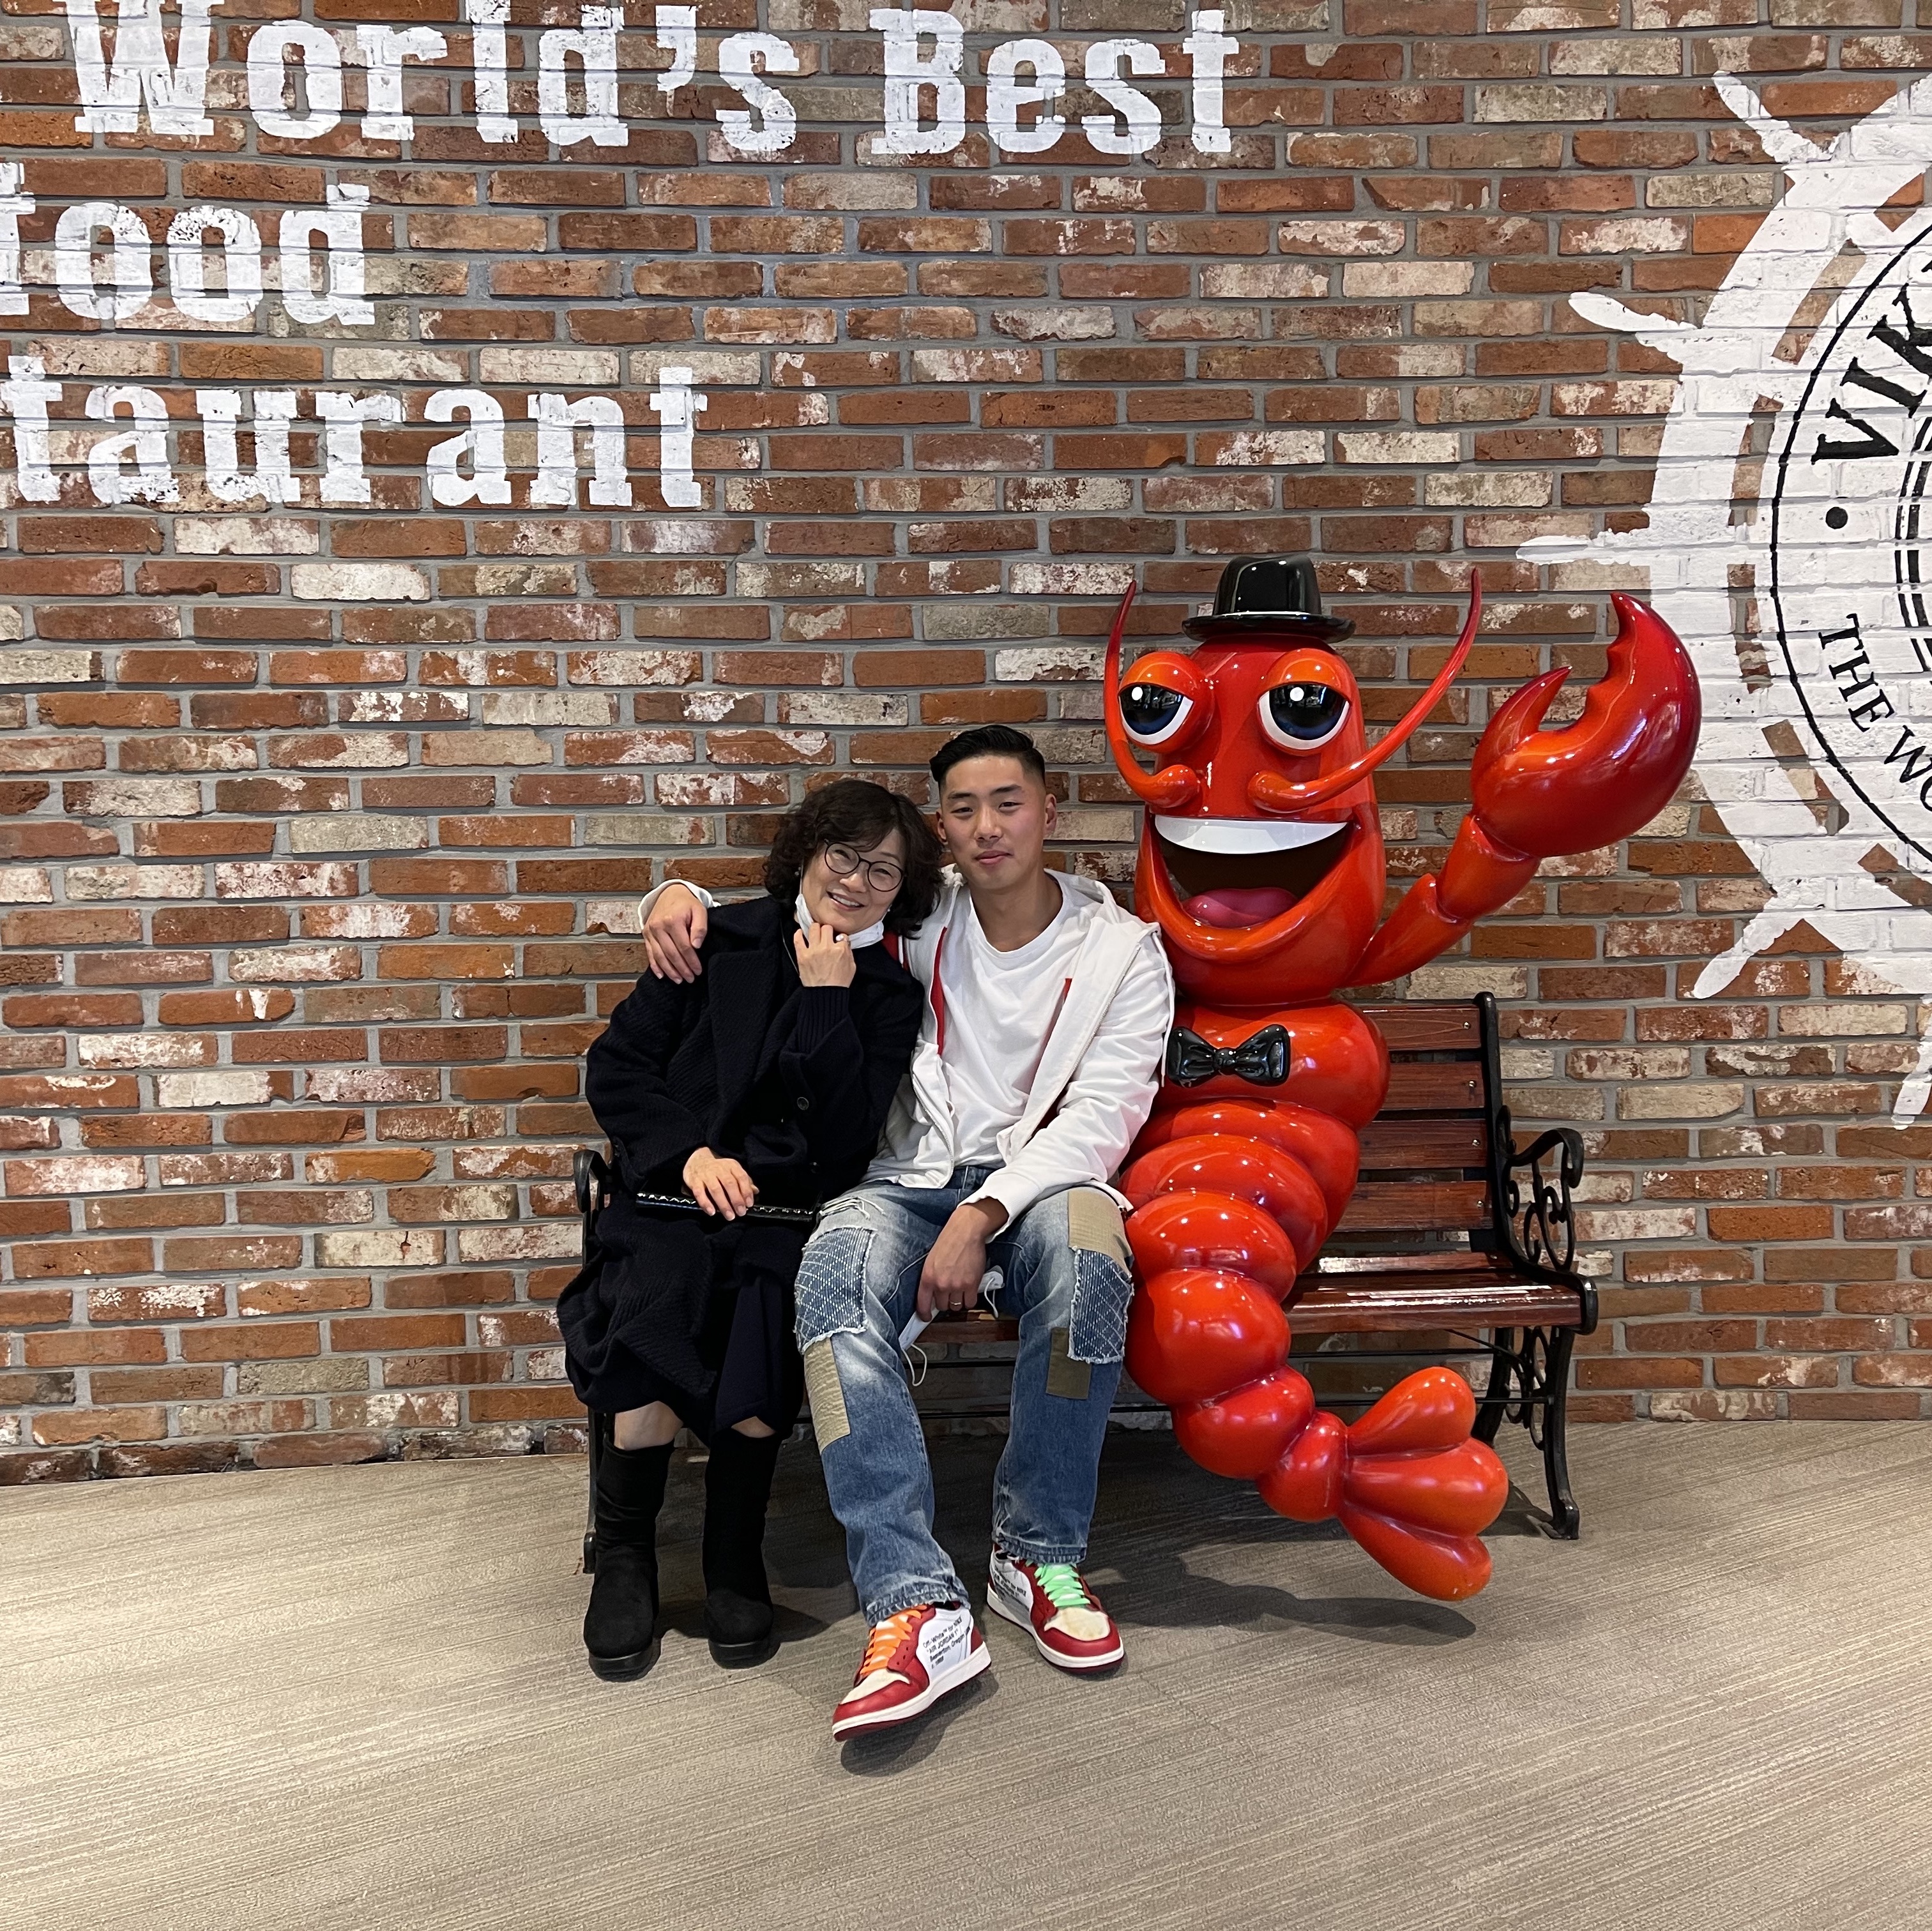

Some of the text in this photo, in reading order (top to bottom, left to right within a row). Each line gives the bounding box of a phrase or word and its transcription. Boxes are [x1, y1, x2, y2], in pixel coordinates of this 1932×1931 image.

[63, 0, 1240, 154] World's Best
[0, 355, 708, 508] taurant
[1811, 261, 1932, 465] VIK
[1818, 612, 1932, 812] THE W
